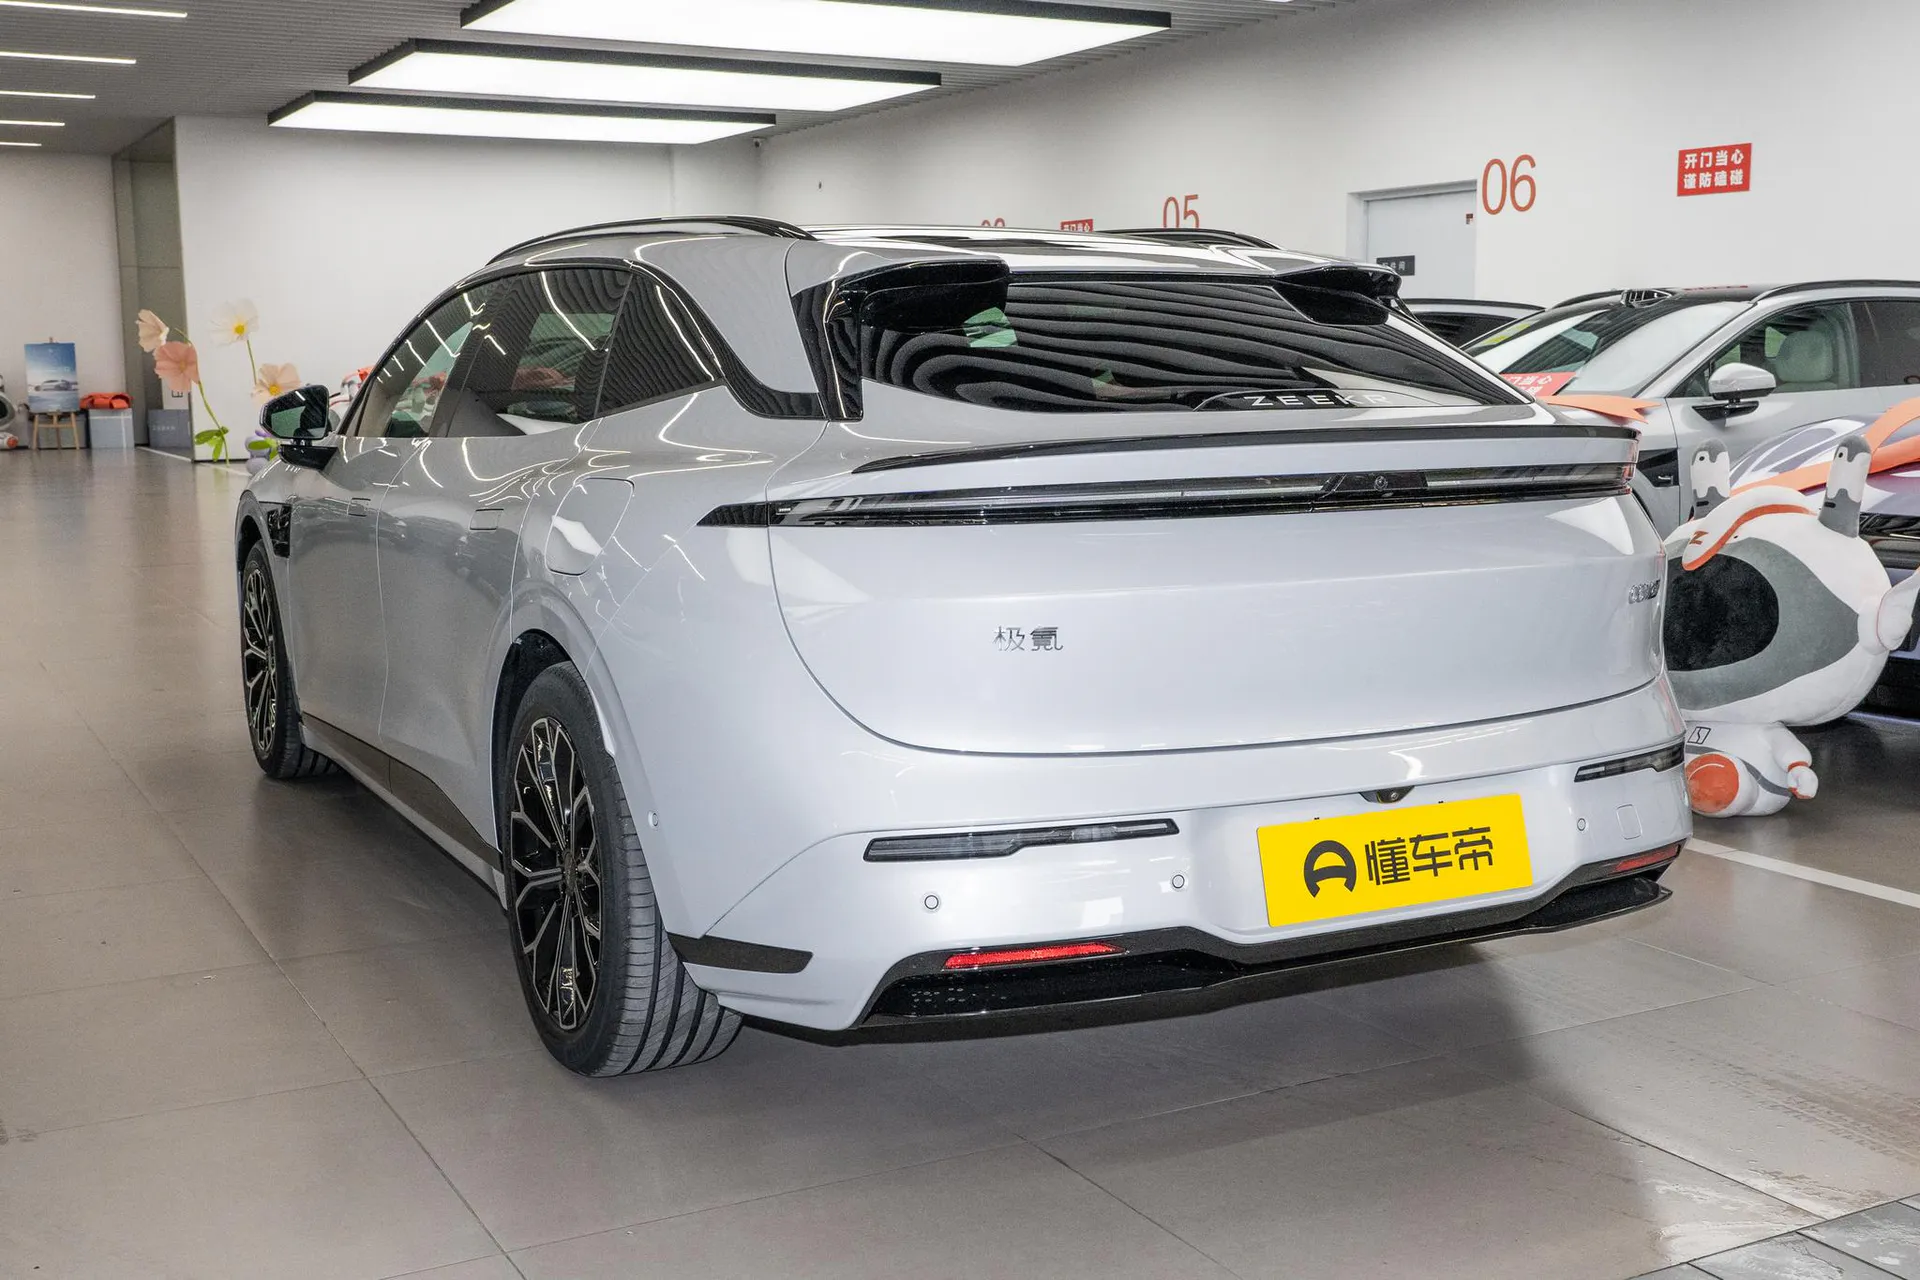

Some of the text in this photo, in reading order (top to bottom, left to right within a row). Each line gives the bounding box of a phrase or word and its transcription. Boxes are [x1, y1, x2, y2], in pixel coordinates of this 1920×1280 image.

[1684, 149, 1744, 169] 开门当心
[1482, 154, 1536, 215] 06
[1163, 194, 1199, 228] 05
[1244, 394, 1392, 407] ZEEKR
[993, 625, 1063, 651] 极氪
[1364, 826, 1493, 885] 懂车帝
